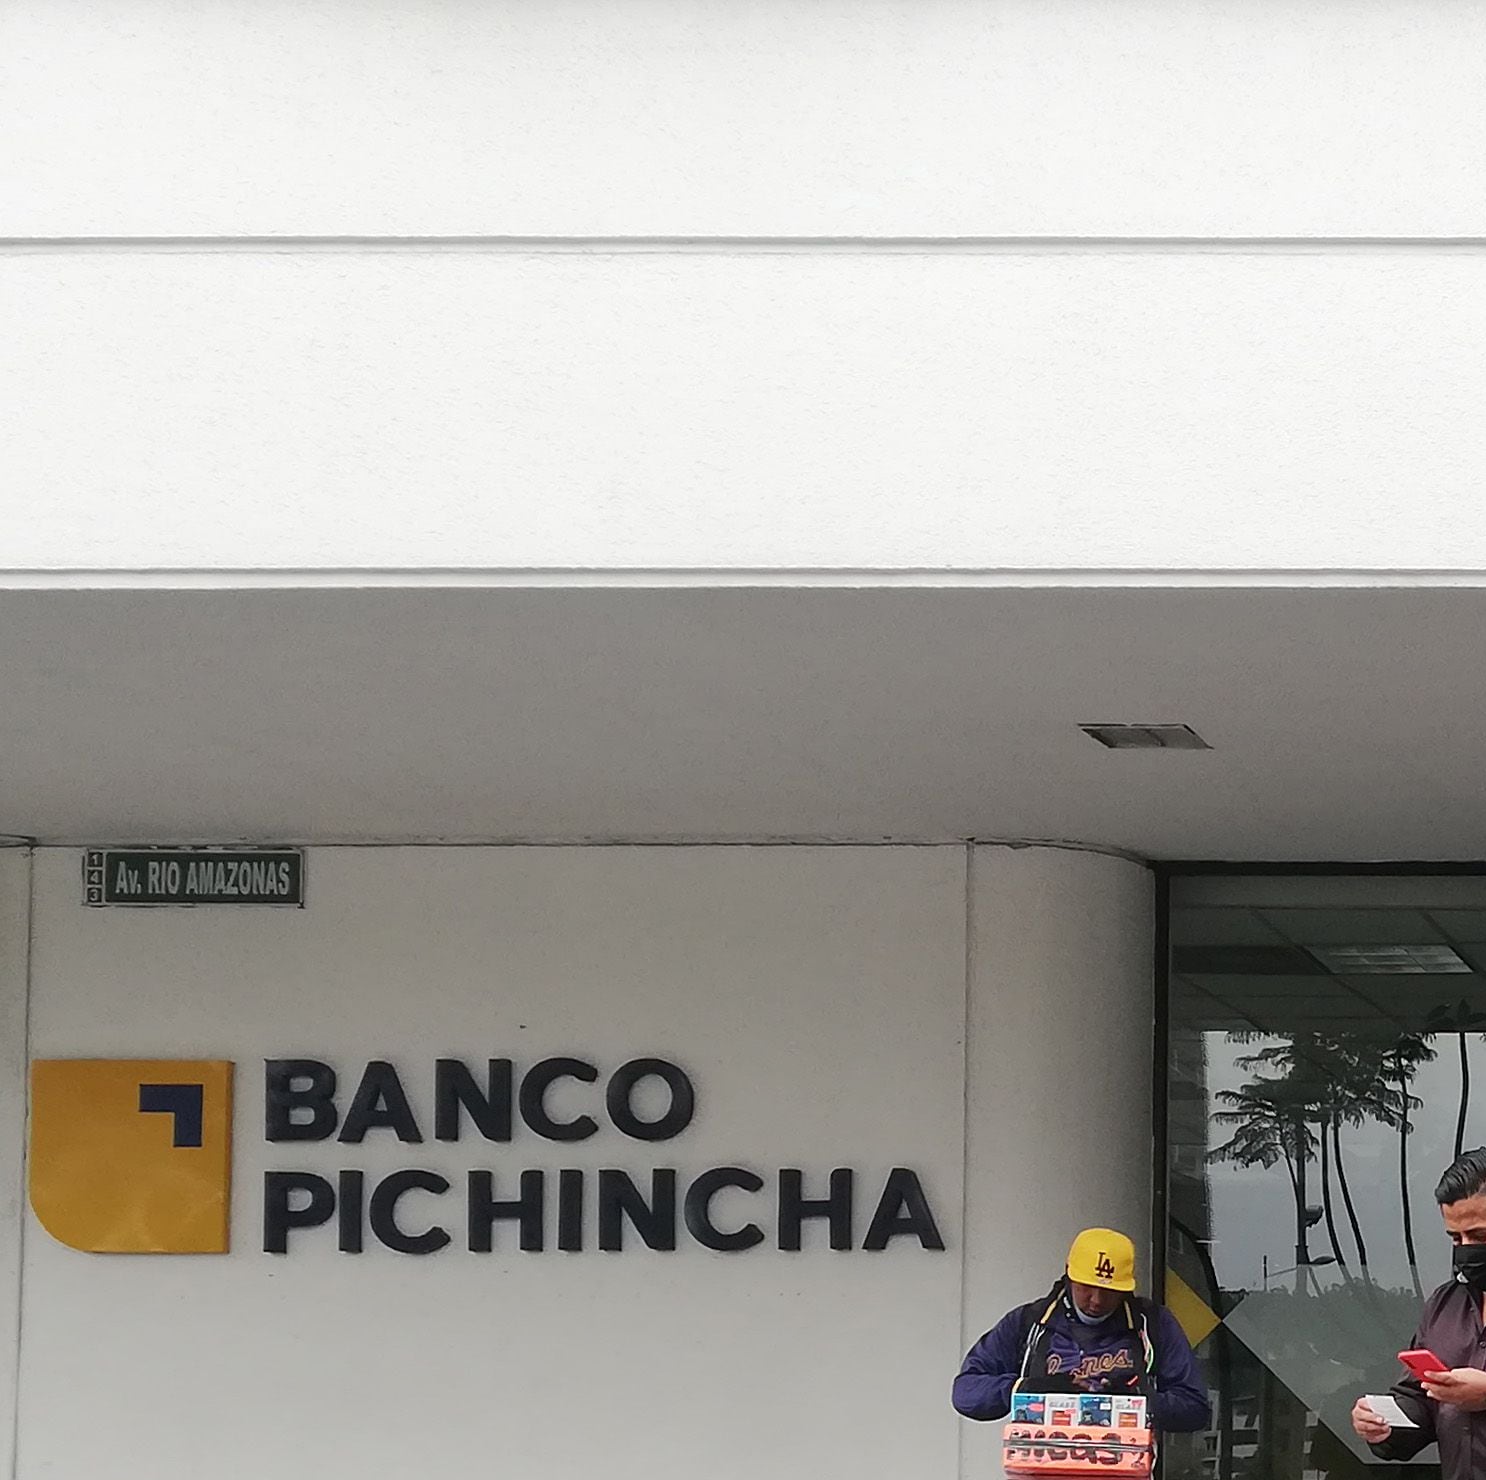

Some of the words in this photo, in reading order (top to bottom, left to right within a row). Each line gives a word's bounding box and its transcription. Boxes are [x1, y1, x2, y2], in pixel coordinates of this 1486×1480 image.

[115, 861, 142, 894] Av.
[148, 861, 180, 895] RIO
[185, 861, 290, 896] AMAZONAS
[264, 1057, 695, 1143] BANCO
[263, 1167, 946, 1254] PICHINCHA
[1095, 1252, 1115, 1279] LA
